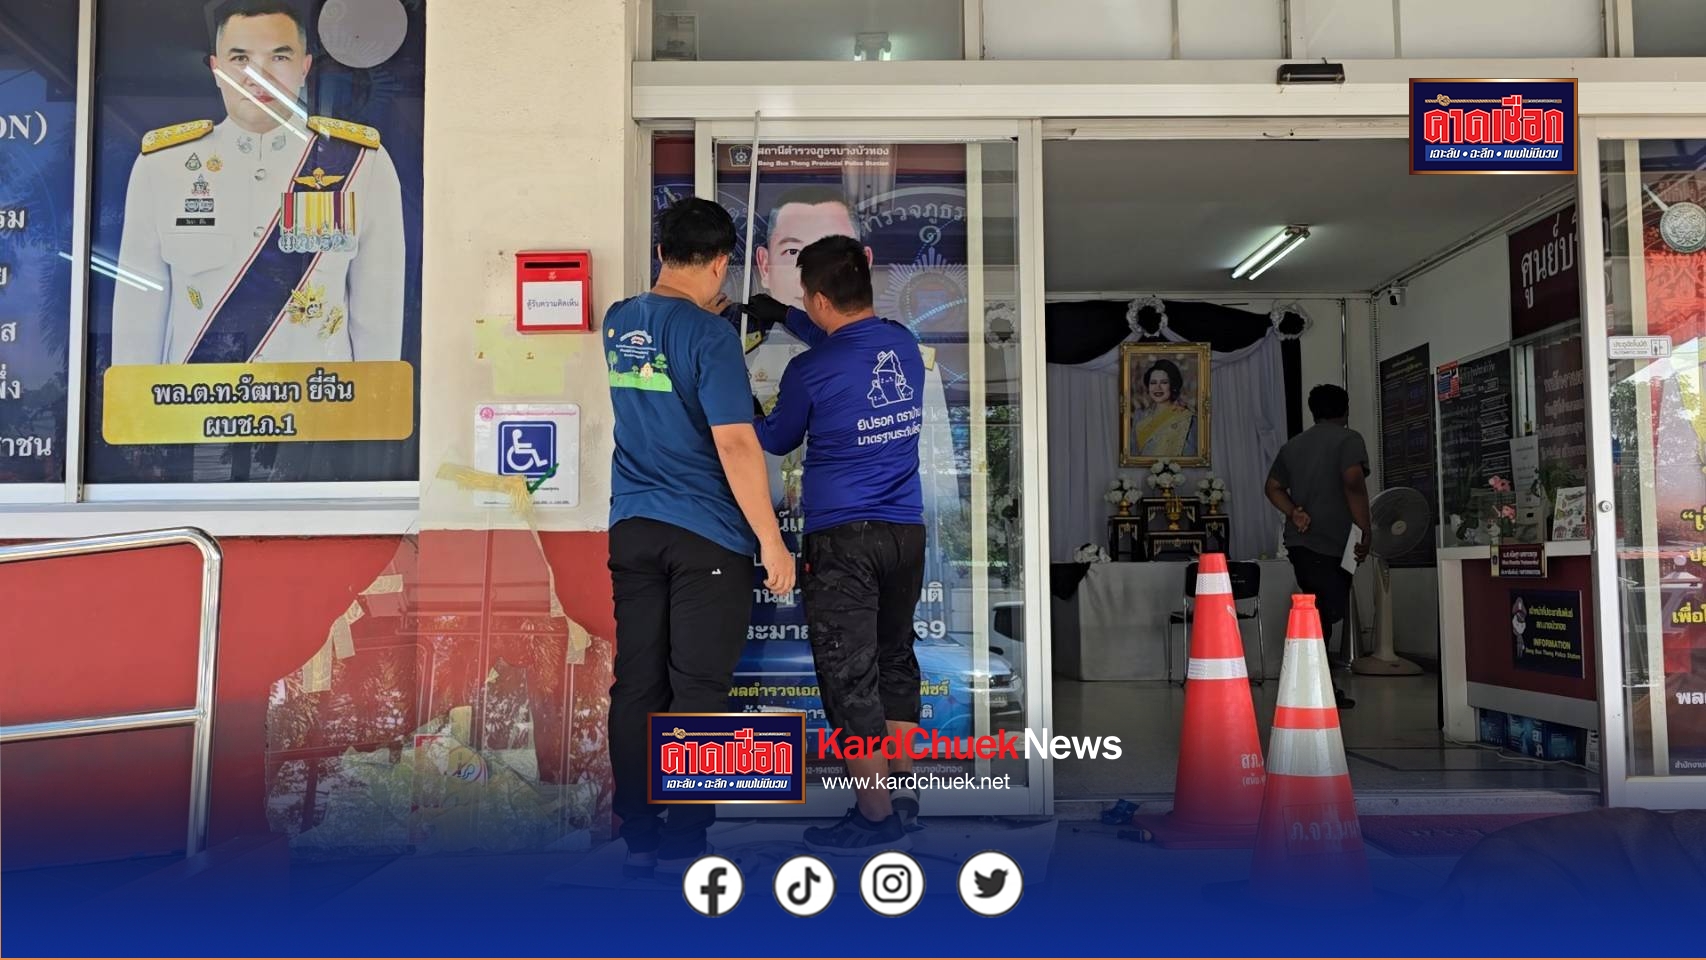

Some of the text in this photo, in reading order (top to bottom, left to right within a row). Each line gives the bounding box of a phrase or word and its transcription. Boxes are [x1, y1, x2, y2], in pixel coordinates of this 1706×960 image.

[1521, 212, 1577, 309] ศูนย์บ
[153, 370, 353, 403] พล.ต.ท.วัฒนา ยี่จีน
[205, 415, 295, 435] ผบช.ภ.1
[0, 436, 52, 457] าชน
[1533, 638, 1571, 649] INFORMATION
[1676, 692, 1706, 705] พล
